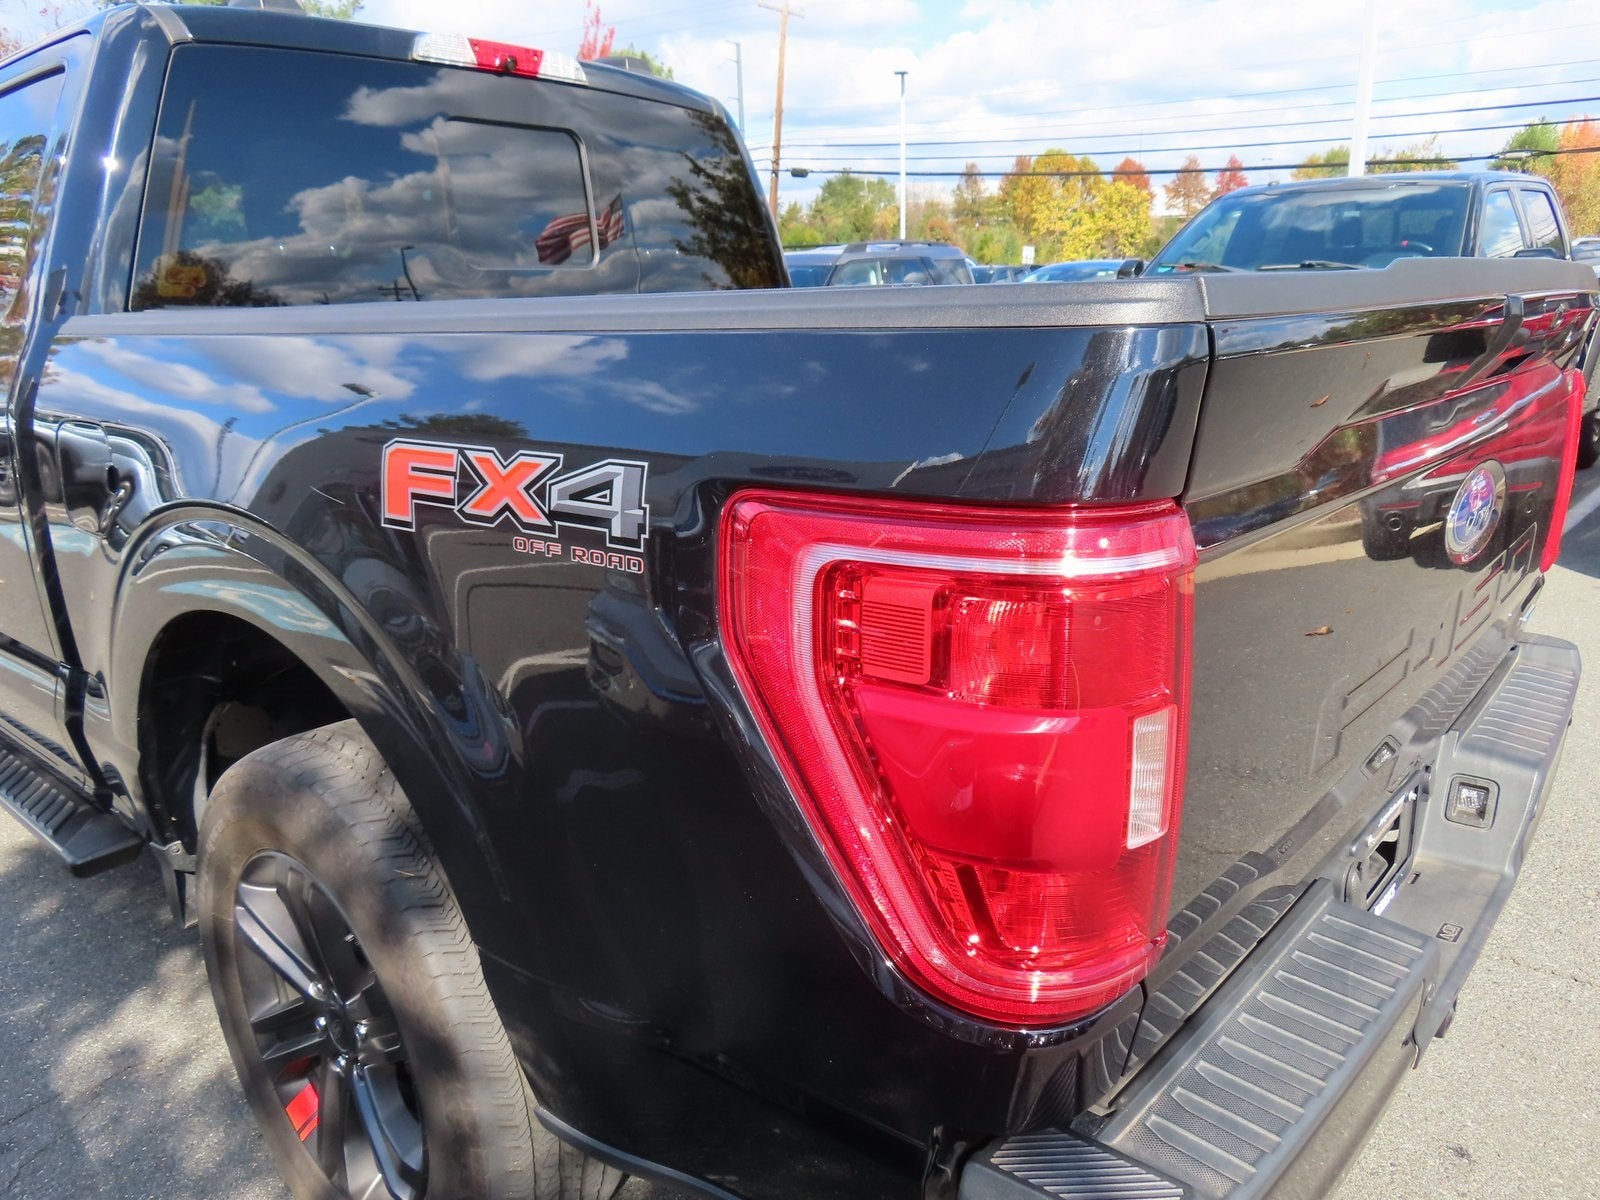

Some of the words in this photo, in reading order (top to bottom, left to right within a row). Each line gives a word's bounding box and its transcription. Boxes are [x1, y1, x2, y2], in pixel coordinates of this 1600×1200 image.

[381, 437, 649, 552] FX4
[513, 536, 562, 557] OFF
[571, 546, 645, 574] ROAD
